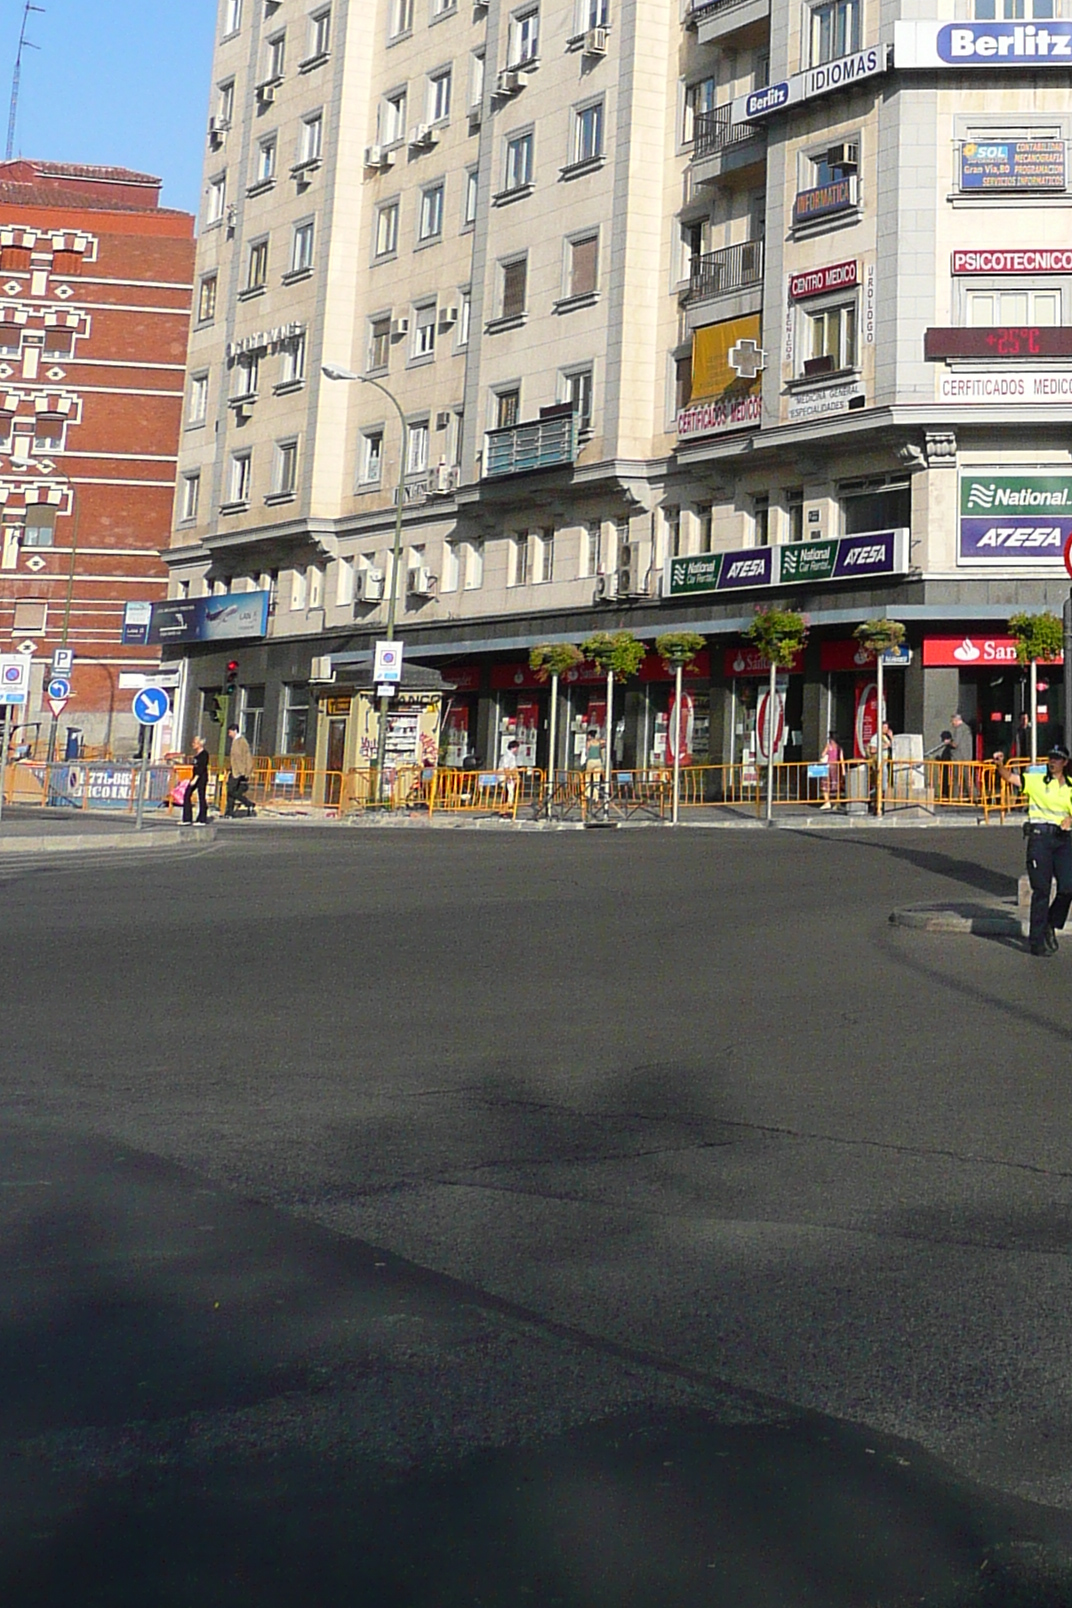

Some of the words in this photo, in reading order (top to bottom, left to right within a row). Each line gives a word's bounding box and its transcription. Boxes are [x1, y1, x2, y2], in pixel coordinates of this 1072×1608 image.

[951, 25, 1072, 56] Berlitz
[811, 51, 877, 92] IDIOMAS
[749, 88, 785, 113] Berlitz
[977, 147, 1006, 158] SOL
[1016, 143, 1063, 152] CONTABILIDAD
[964, 165, 984, 174] Gran
[982, 177, 1016, 187] SERVICIOS
[797, 181, 849, 215] INFORMATICA
[791, 274, 823, 295] CENTRO
[825, 264, 856, 285] MEDICO
[986, 328, 1040, 354] +25°C
[796, 392, 826, 405] MEDICINA
[829, 385, 860, 399] GENERAL
[943, 379, 1024, 396] CERFITICADOS
[678, 404, 727, 434] CERTIFICADOS
[790, 401, 845, 419] ESPECIALIDADES
[994, 488, 1069, 505] National
[976, 528, 1061, 547] ATESA
[799, 546, 830, 561] National
[843, 545, 886, 566] ATESA
[687, 560, 715, 575] National
[726, 559, 766, 579] ATESA
[57, 652, 68, 666] P
